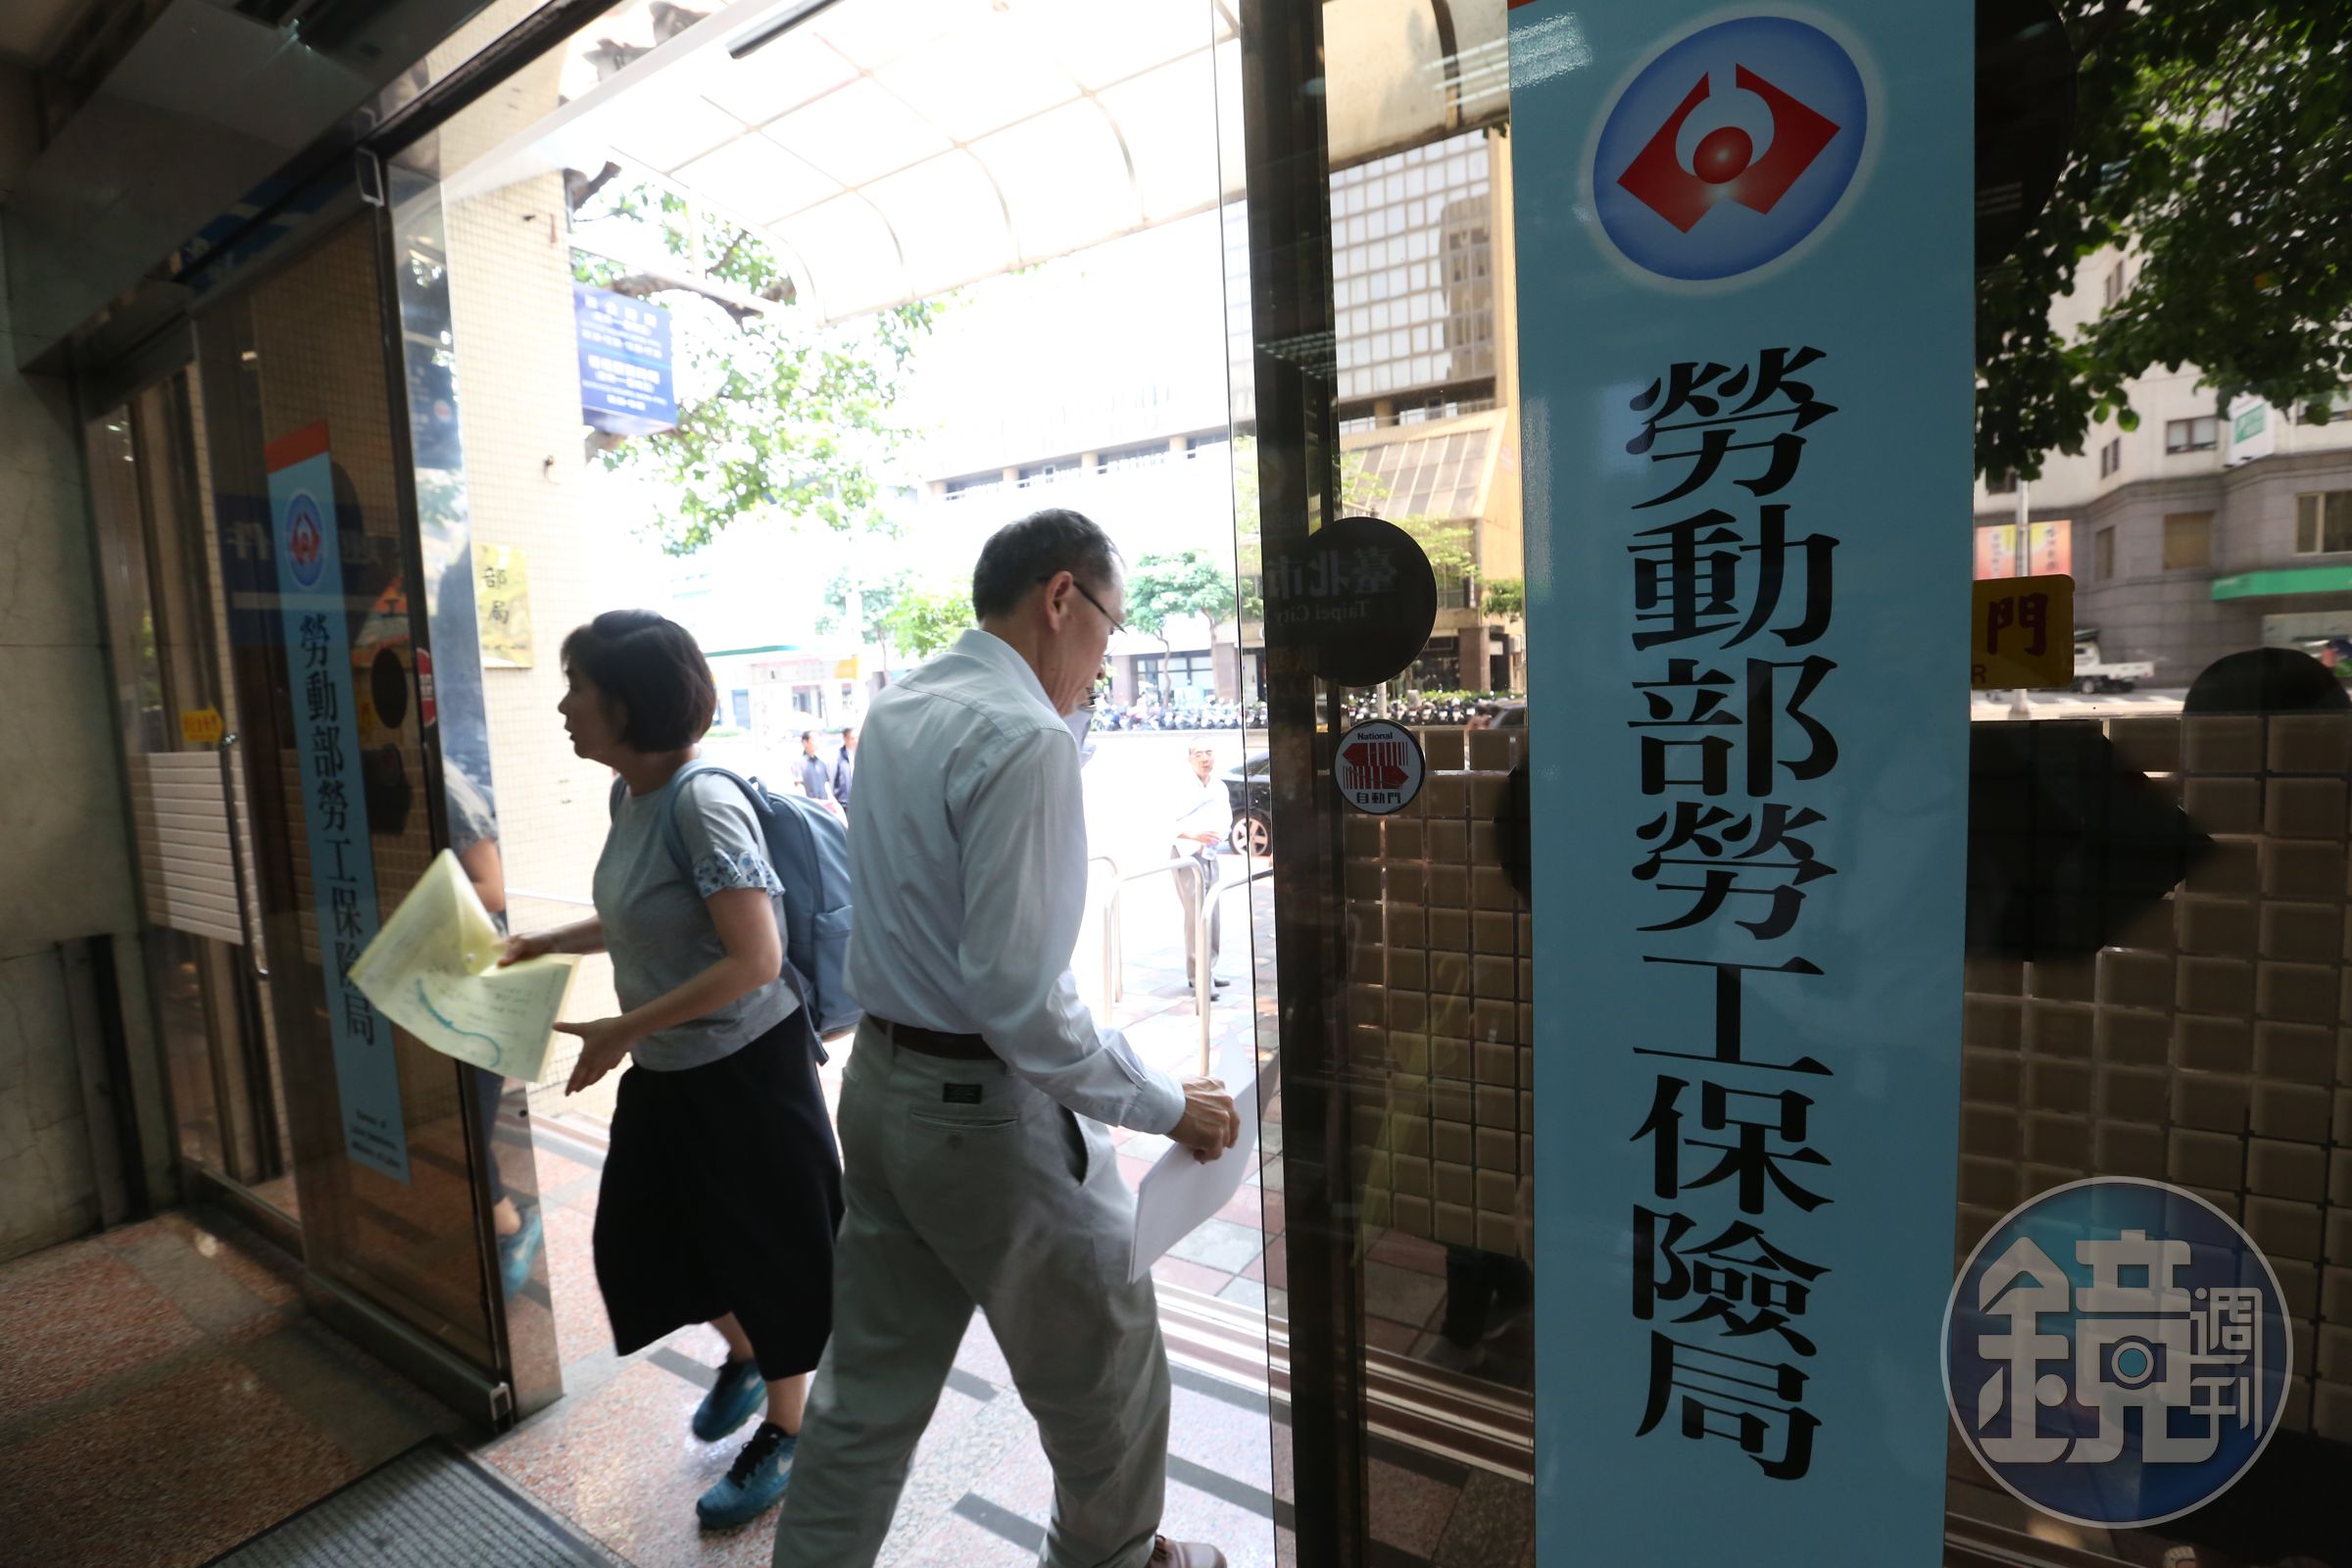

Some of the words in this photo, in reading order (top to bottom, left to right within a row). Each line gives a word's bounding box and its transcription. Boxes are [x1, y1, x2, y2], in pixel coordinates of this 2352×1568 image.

[1987, 593, 2048, 657] 門
[1357, 732, 1394, 741] National
[1356, 792, 1401, 804] 自動門
[1627, 346, 1839, 1481] 勞動部勞工保險局
